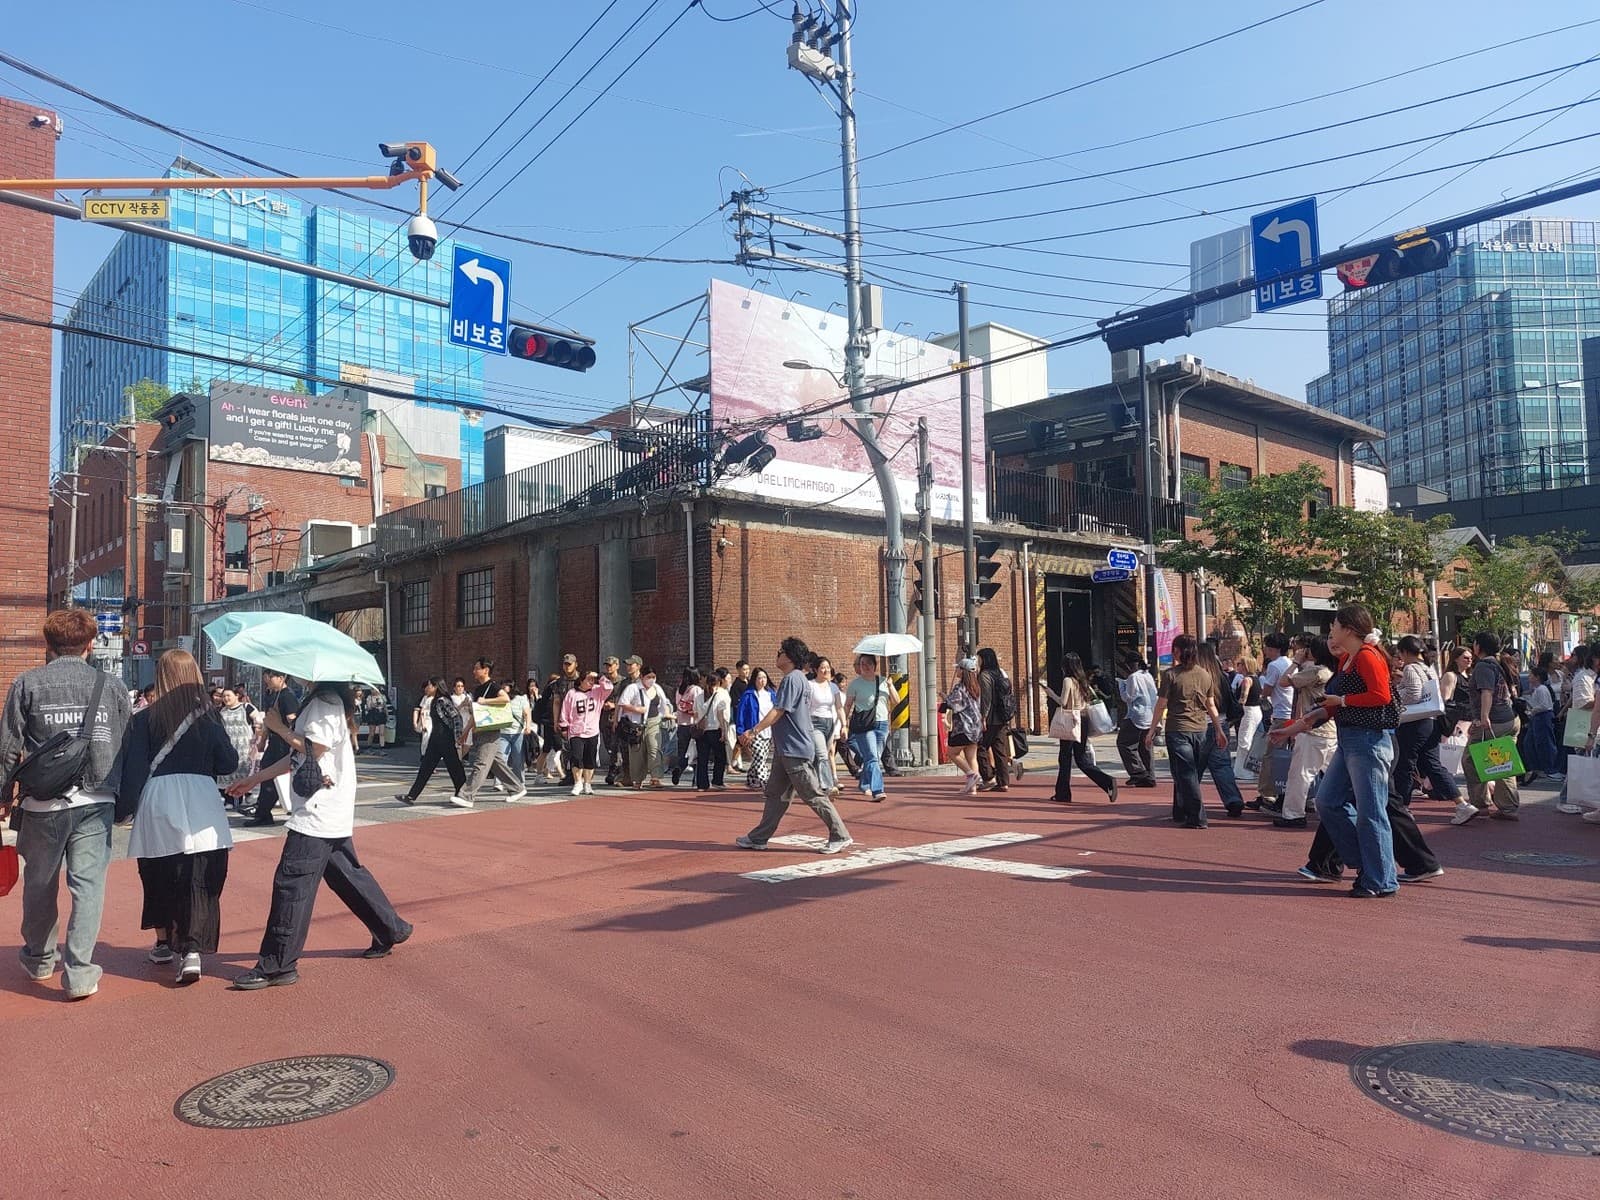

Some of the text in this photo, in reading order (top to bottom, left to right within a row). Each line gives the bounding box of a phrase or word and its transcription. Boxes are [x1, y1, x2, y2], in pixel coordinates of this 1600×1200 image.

[91, 202, 161, 216] CCTV 작동중
[1260, 272, 1317, 304] 비보호
[453, 319, 504, 350] 비보호
[270, 395, 309, 409] event
[221, 402, 235, 412] Ah
[247, 407, 271, 417] wear
[271, 409, 299, 421] florals
[299, 413, 316, 424] just
[316, 418, 334, 427] one
[334, 420, 353, 431] day,
[225, 414, 244, 423] and
[250, 418, 266, 427] get
[266, 420, 273, 428] a
[274, 421, 292, 431] gift!
[293, 423, 320, 436] Lucky
[320, 428, 337, 437] me.
[44, 711, 108, 725] RUNHRD
